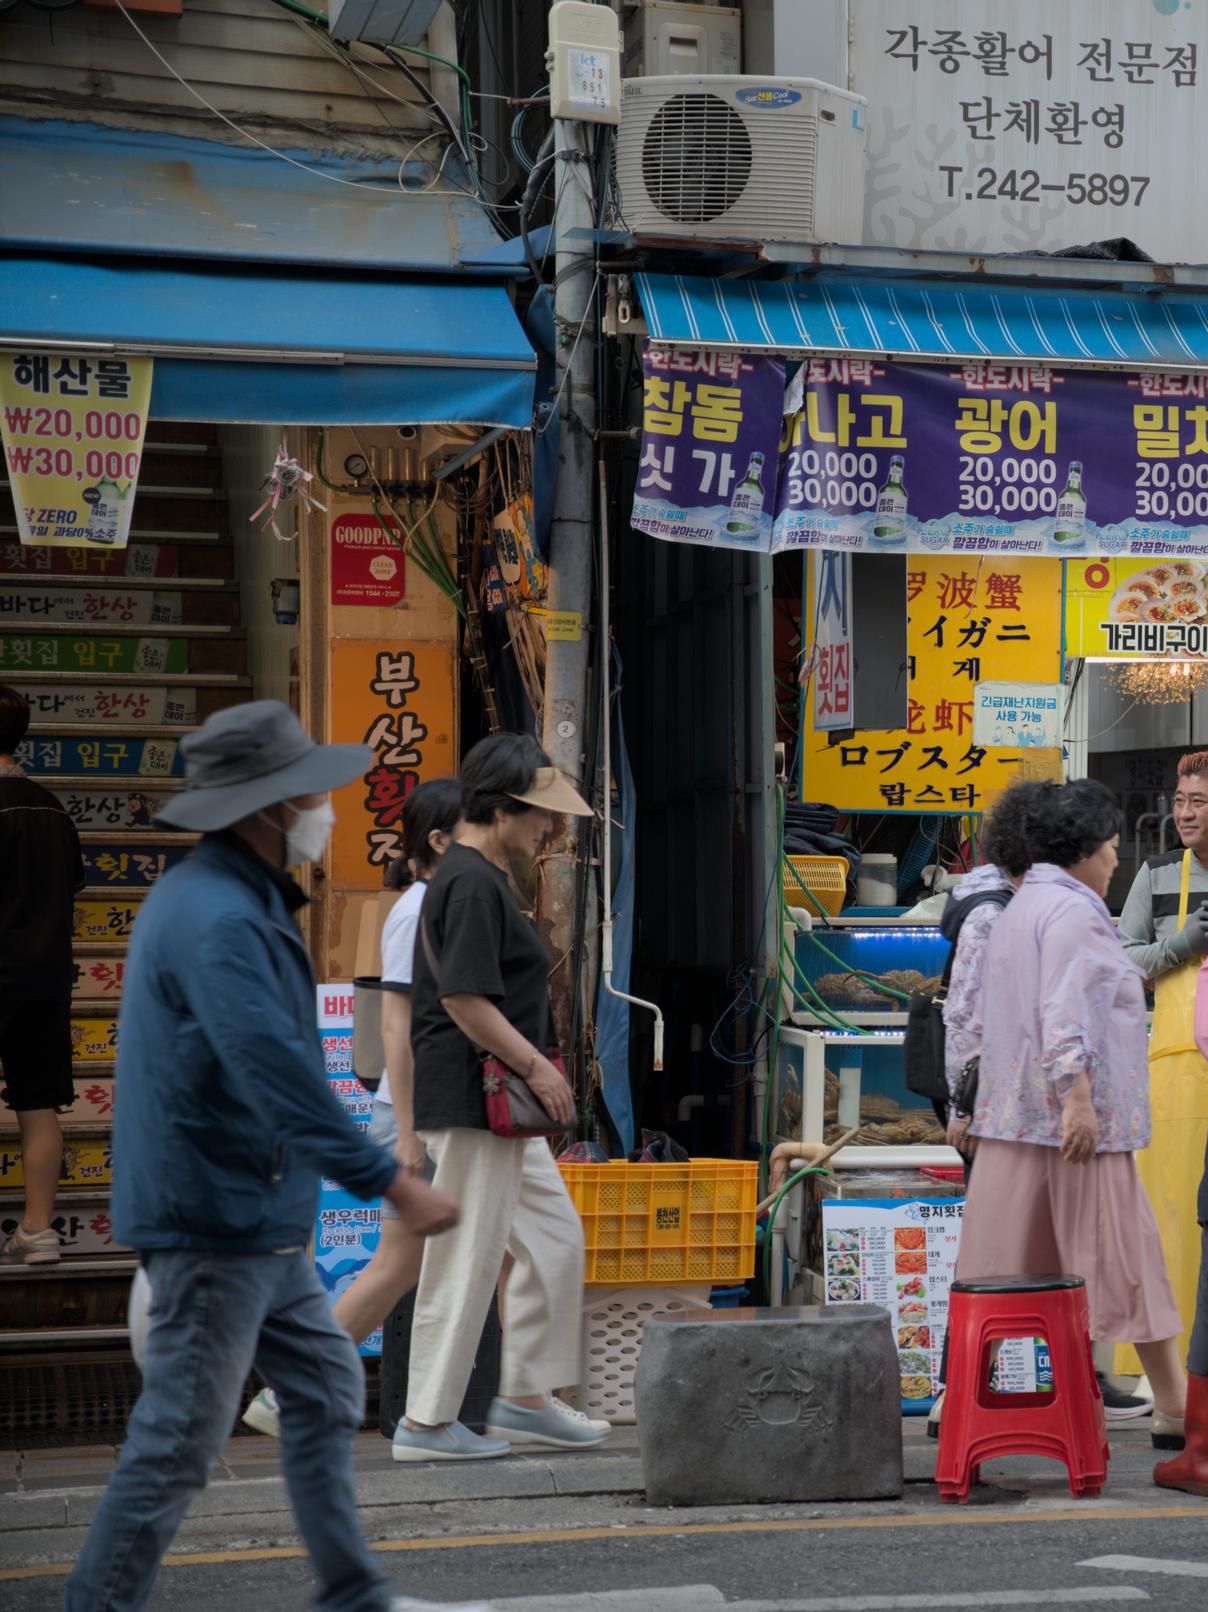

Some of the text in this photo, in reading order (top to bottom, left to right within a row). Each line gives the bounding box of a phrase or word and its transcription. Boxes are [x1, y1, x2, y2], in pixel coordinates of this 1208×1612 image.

[580, 53, 597, 66] kt
[884, 25, 1200, 88] 각종활어 전문점
[958, 97, 1126, 149] 단체환영
[939, 165, 1151, 207] T.242-5897
[13, 355, 131, 398] 해산물
[644, 376, 743, 443] 참돔
[954, 398, 1057, 455] 광어
[641, 444, 735, 497] 싯 가
[788, 450, 877, 480] 20,000
[959, 456, 1057, 485] 20,000
[789, 479, 877, 508] 30,000
[959, 485, 1057, 515] 30,000
[36, 509, 78, 524] ZERO
[0, 543, 115, 571] 횟집 입구
[953, 536, 1042, 551] 깔끔함이 살아난다!
[1130, 541, 1175, 554] 깔끔함이
[83, 593, 138, 621] 한상
[907, 615, 1031, 648] イガニ
[1101, 623, 1208, 653] 가리비구이
[73, 640, 124, 667] 입구
[94, 691, 150, 719] 한상
[981, 696, 1057, 709] 긴급재난지원금
[996, 711, 1041, 722] 사용 가능
[563, 725, 569, 733] 2
[77, 742, 128, 769] 입구
[840, 741, 1022, 775] ロブスター
[880, 782, 981, 808] 랍스타
[67, 795, 125, 824] 한상
[83, 853, 167, 881] 횟집
[320, 1234, 361, 1247] (2인분)
